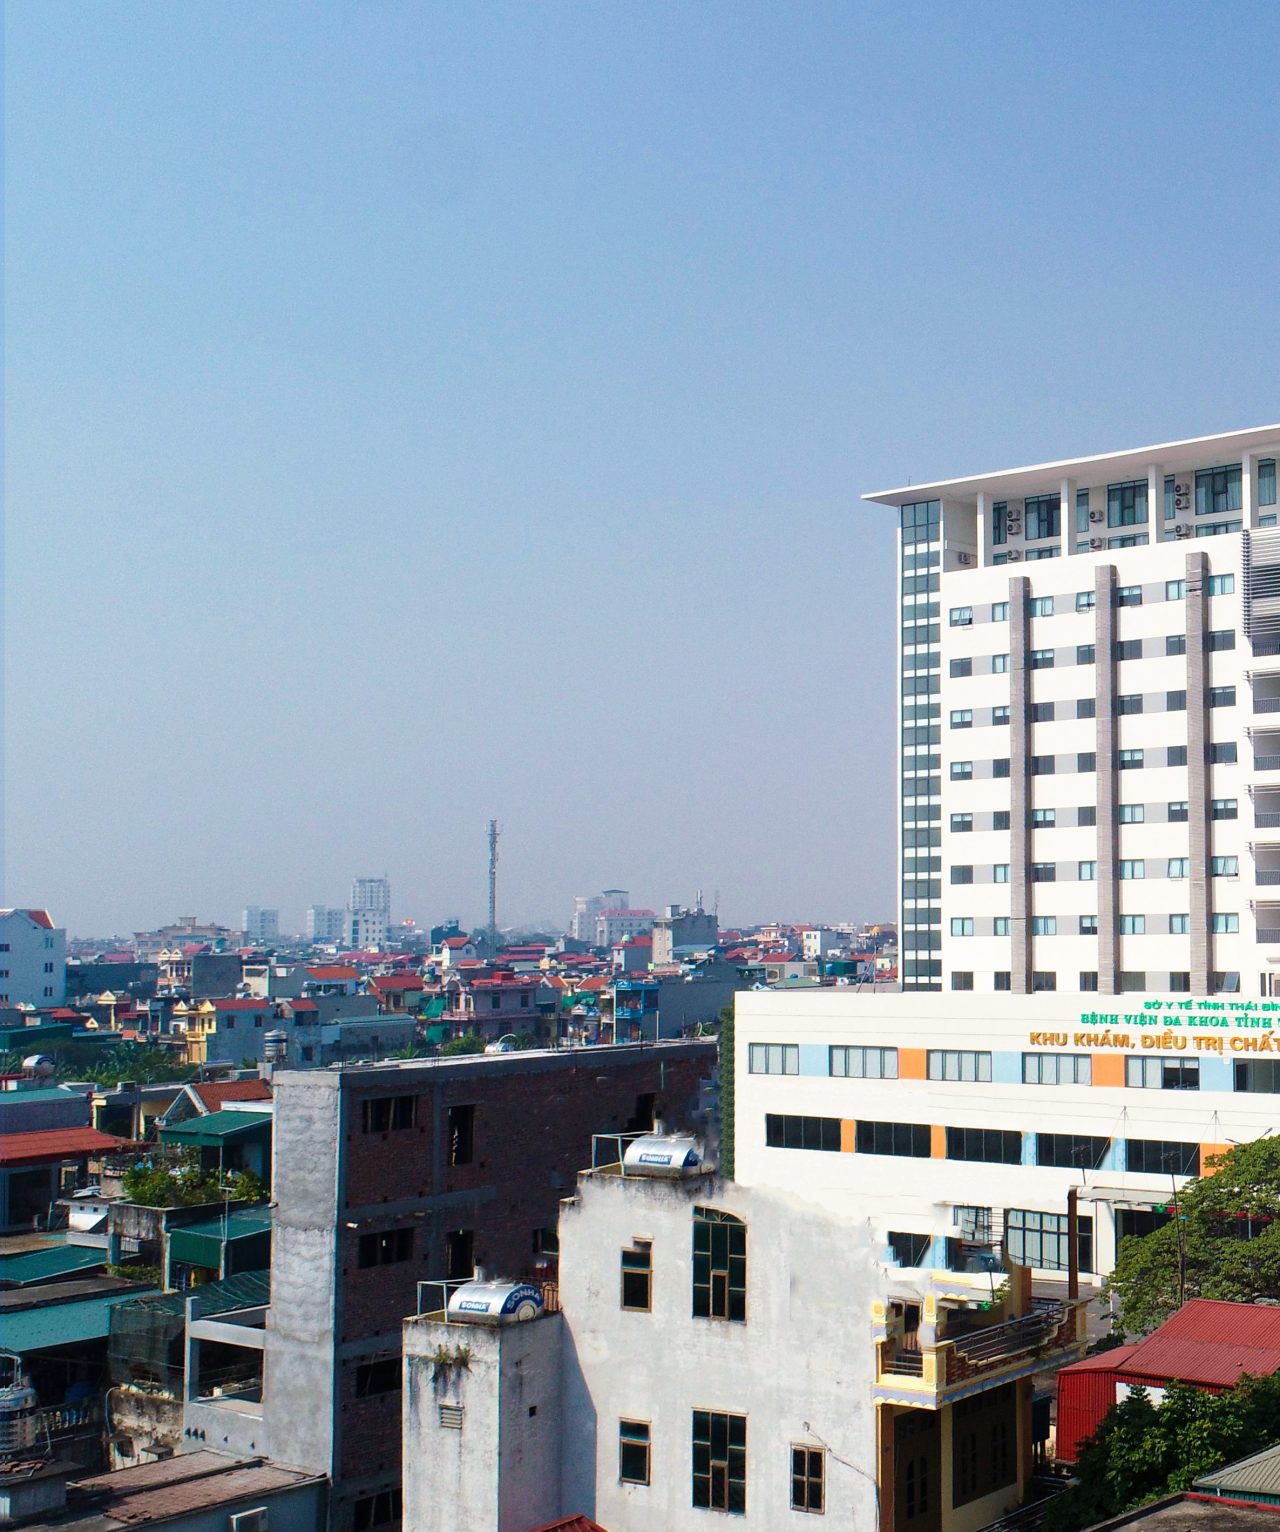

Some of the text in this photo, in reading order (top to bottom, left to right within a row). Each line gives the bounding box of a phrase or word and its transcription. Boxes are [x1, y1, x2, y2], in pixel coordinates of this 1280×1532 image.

[1165, 1001, 1174, 1010] Y
[1080, 1011, 1119, 1027] BỆNH
[1124, 1012, 1158, 1028] VIỆN
[1163, 1015, 1182, 1026] ĐA
[1187, 1016, 1229, 1027] KHOA
[1030, 1031, 1068, 1047] KHU
[1074, 1029, 1135, 1049] KHÁM,
[1141, 1029, 1187, 1050] ĐIỀU
[1192, 1036, 1224, 1055] TRỊ
